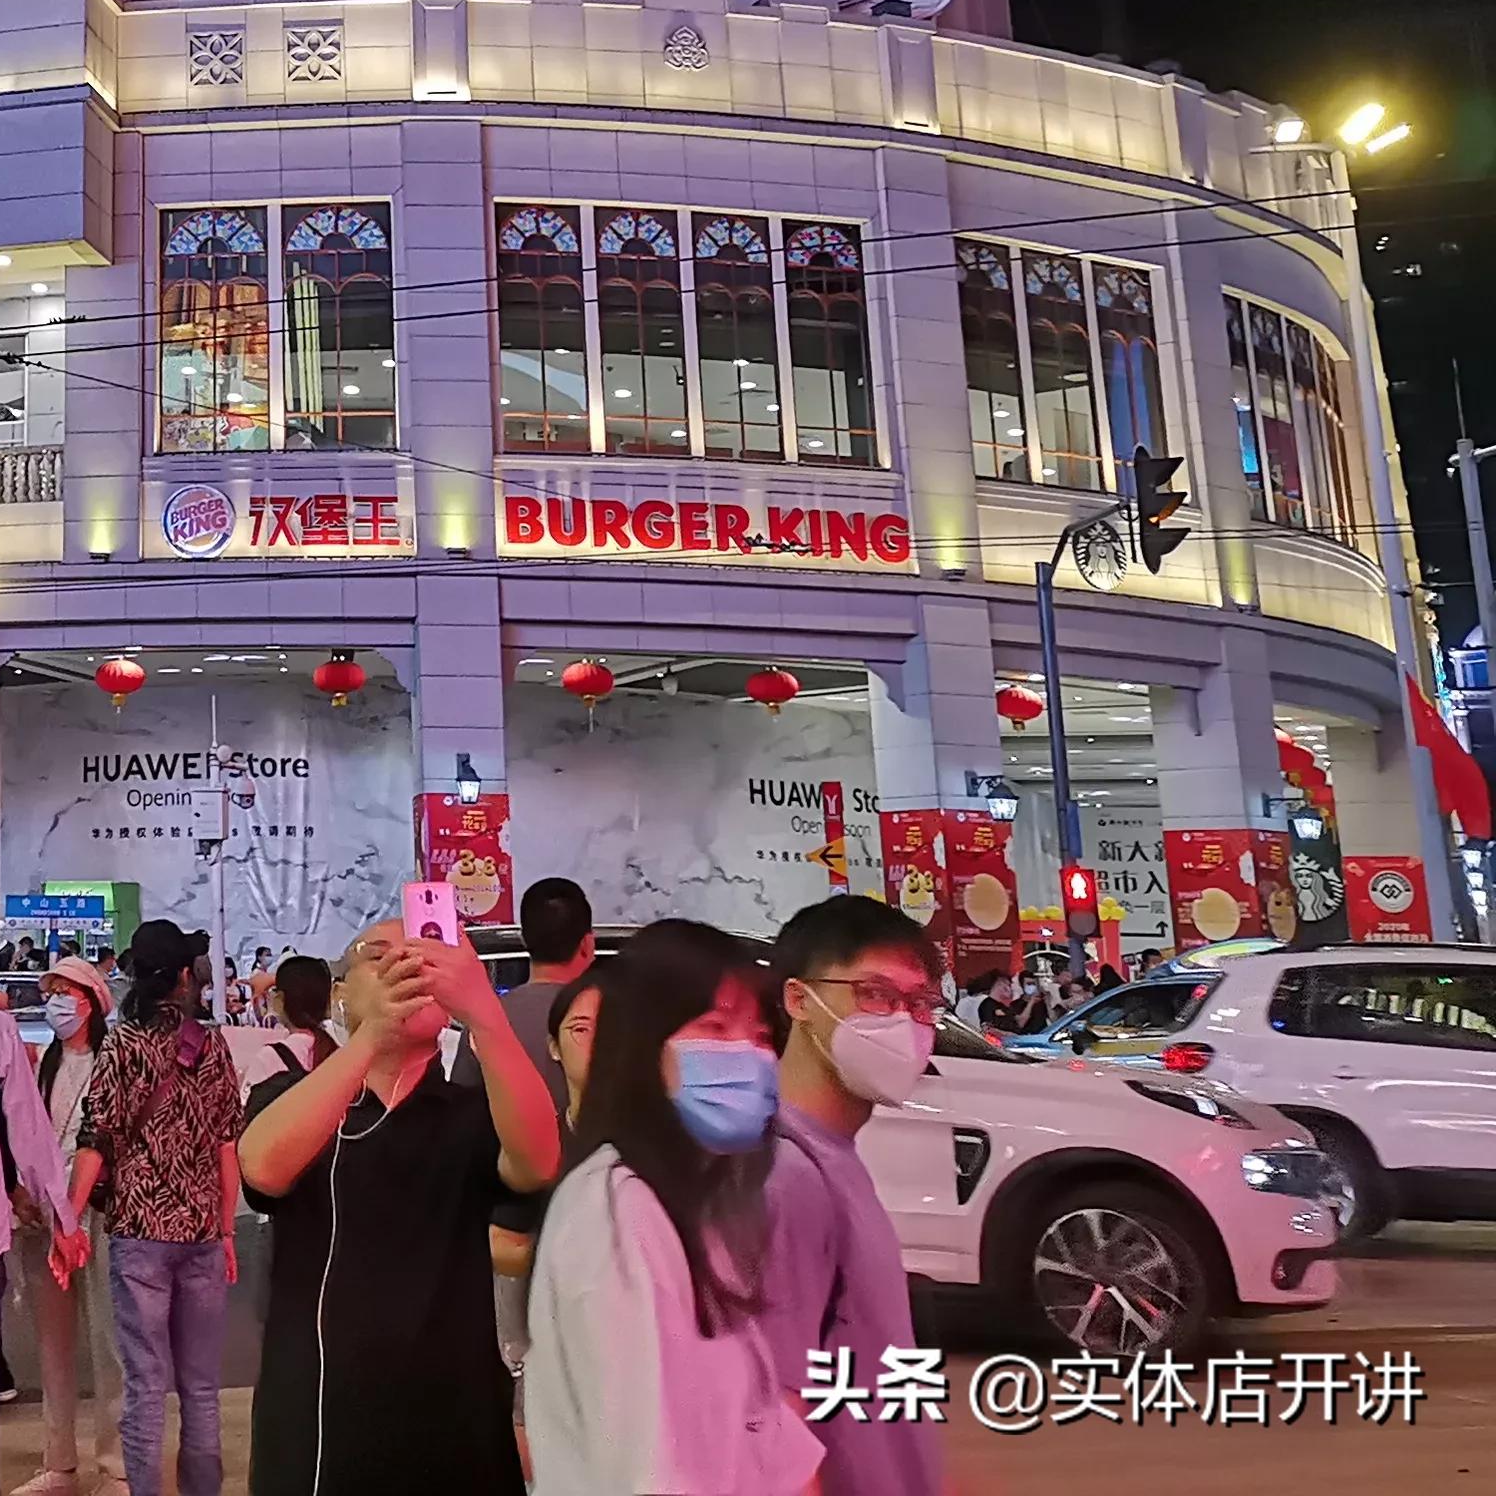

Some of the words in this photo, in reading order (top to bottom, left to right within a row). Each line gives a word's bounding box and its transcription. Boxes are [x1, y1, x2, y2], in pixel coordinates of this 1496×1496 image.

[170, 498, 224, 525] BURGER
[173, 511, 228, 543] KING
[248, 494, 401, 547] 汉堡王
[505, 496, 752, 555] BURGER
[767, 506, 912, 564] KING
[126, 788, 192, 811] Openin
[749, 778, 823, 809] HUAW
[852, 788, 881, 814] Sto
